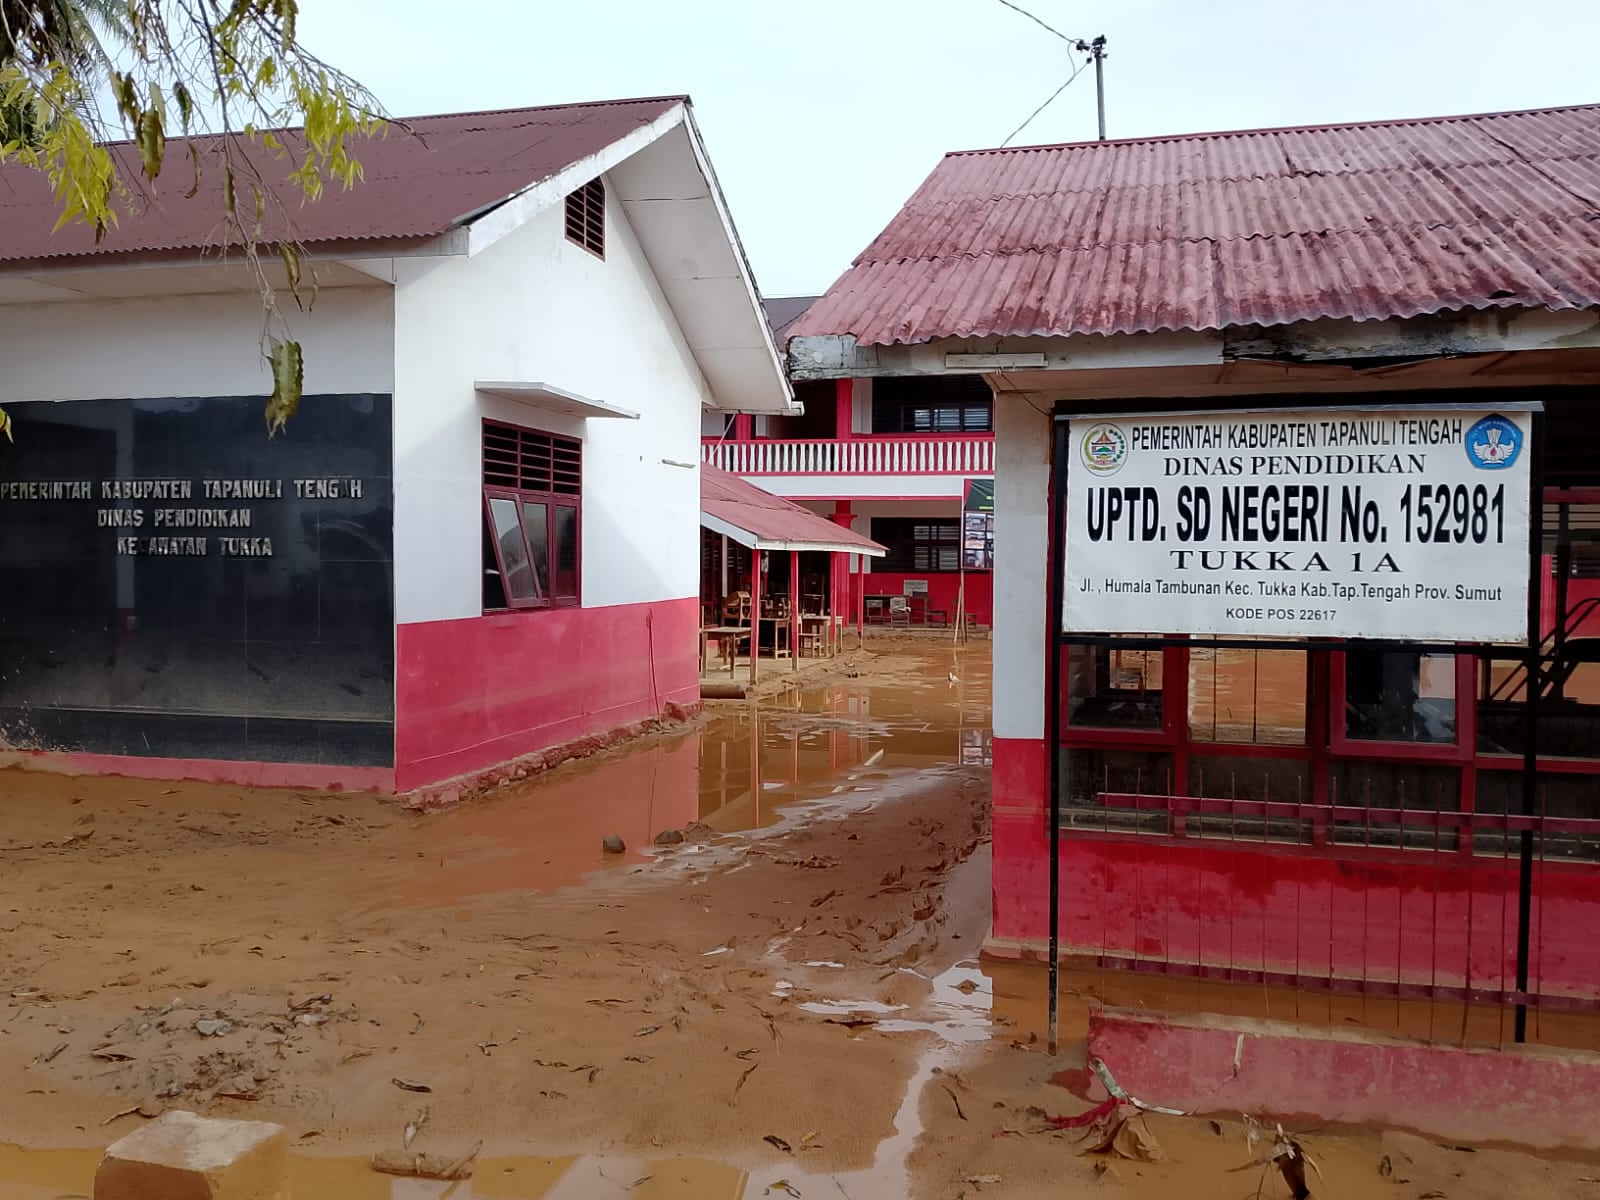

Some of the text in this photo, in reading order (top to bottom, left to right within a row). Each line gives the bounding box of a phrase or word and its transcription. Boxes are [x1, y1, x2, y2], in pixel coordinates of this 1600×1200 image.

[1132, 425, 1223, 450] PEMERINTAH
[1228, 422, 1317, 449] KABUPATEN
[1320, 420, 1396, 446] TAPANULI
[1399, 418, 1462, 444] TENGAH
[1163, 453, 1426, 476] DINAS PENDIDIKAN
[0, 481, 92, 500] PEMERINTAH
[101, 480, 192, 499] KABUPATEN
[203, 479, 282, 499] TAPANULI
[97, 508, 251, 527] DINAS PENDIDIKAN
[1087, 483, 1505, 544] UPTD. SD NEGERI No. 152981
[117, 537, 273, 556] KEAMATAN TUKKA
[1169, 550, 1404, 573] TUKKA 1A
[1105, 578, 1151, 593] Humala
[1155, 579, 1221, 595] Tambunan
[1225, 580, 1253, 596] Kec.
[1257, 581, 1297, 597] Tukka
[1415, 584, 1450, 599] Prov.
[1455, 584, 1502, 601] Sumut
[1226, 608, 1337, 621] KODE POS 22617
